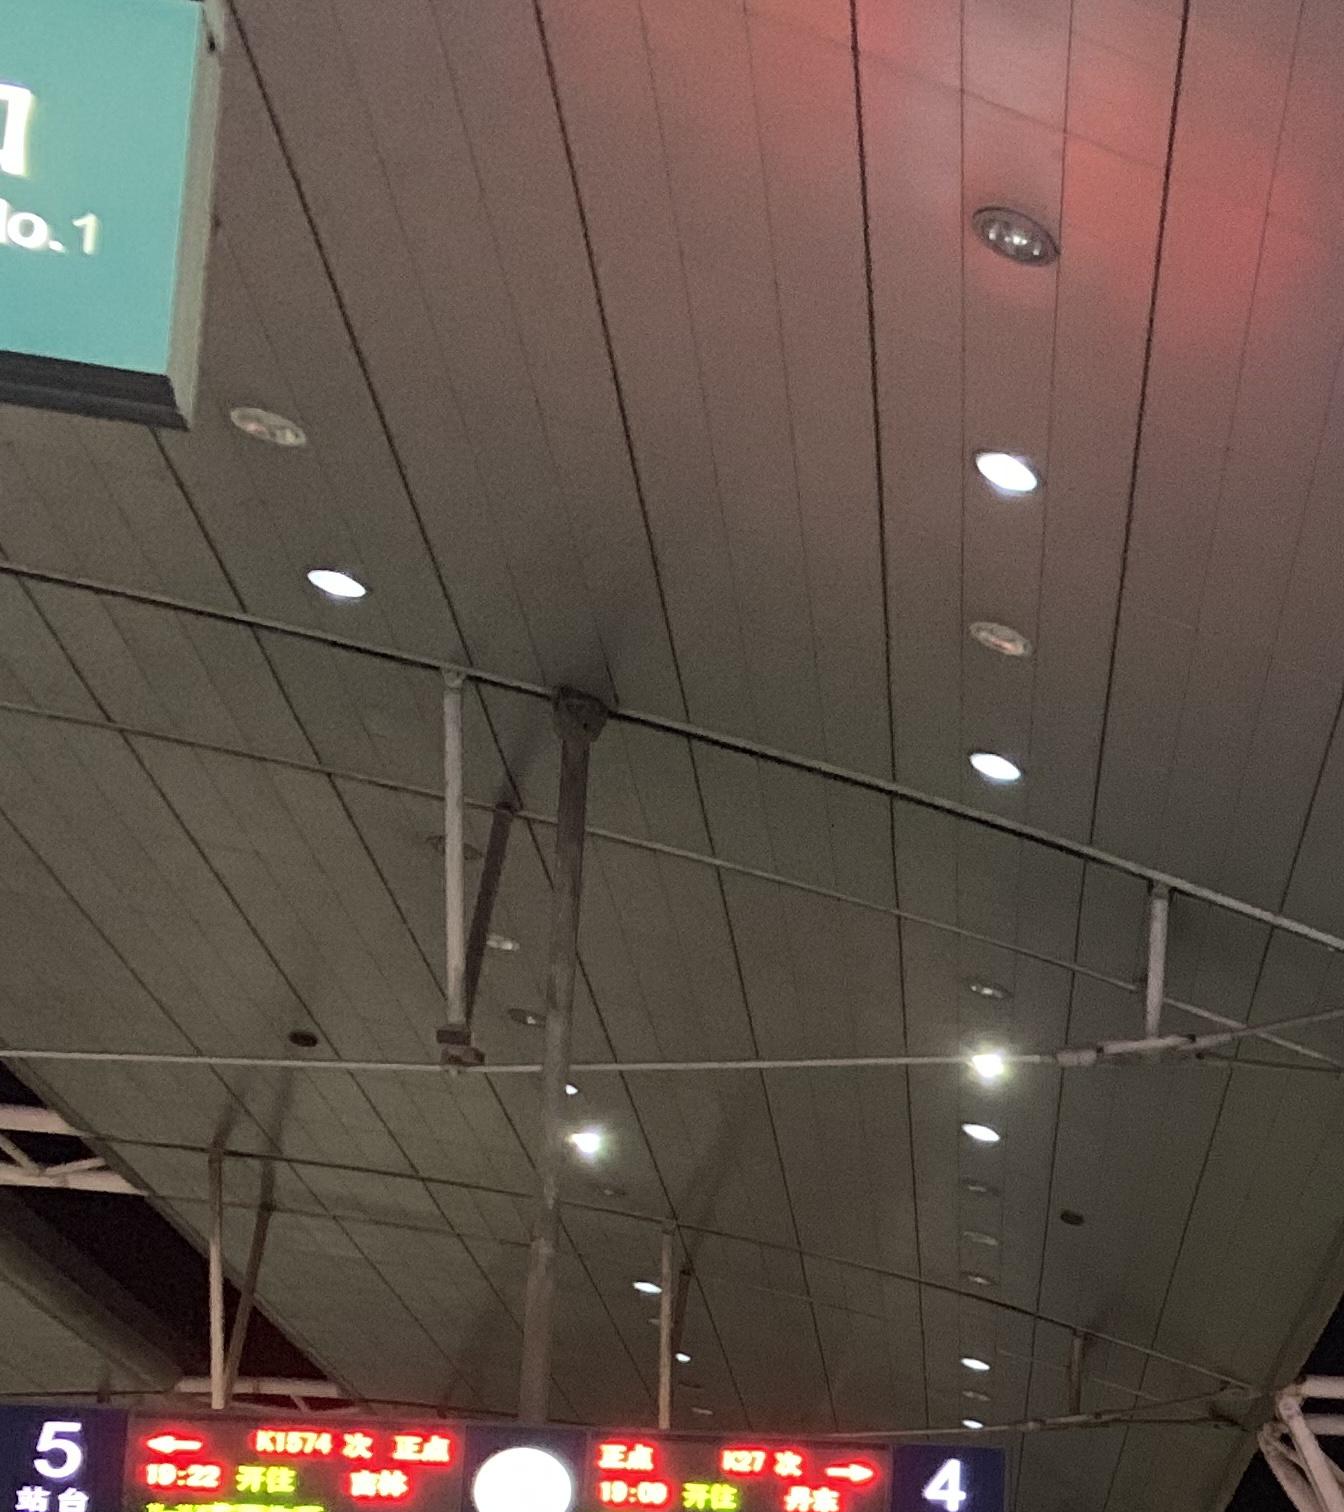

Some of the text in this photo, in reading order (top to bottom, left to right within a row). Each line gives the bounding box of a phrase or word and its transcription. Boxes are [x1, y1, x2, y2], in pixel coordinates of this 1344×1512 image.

[34, 1421, 82, 1478] 5
[255, 1429, 450, 1463] K1574 次 正点
[236, 1465, 297, 1493] 开往
[682, 1481, 738, 1511] 开往
[921, 1458, 967, 1512] 4
